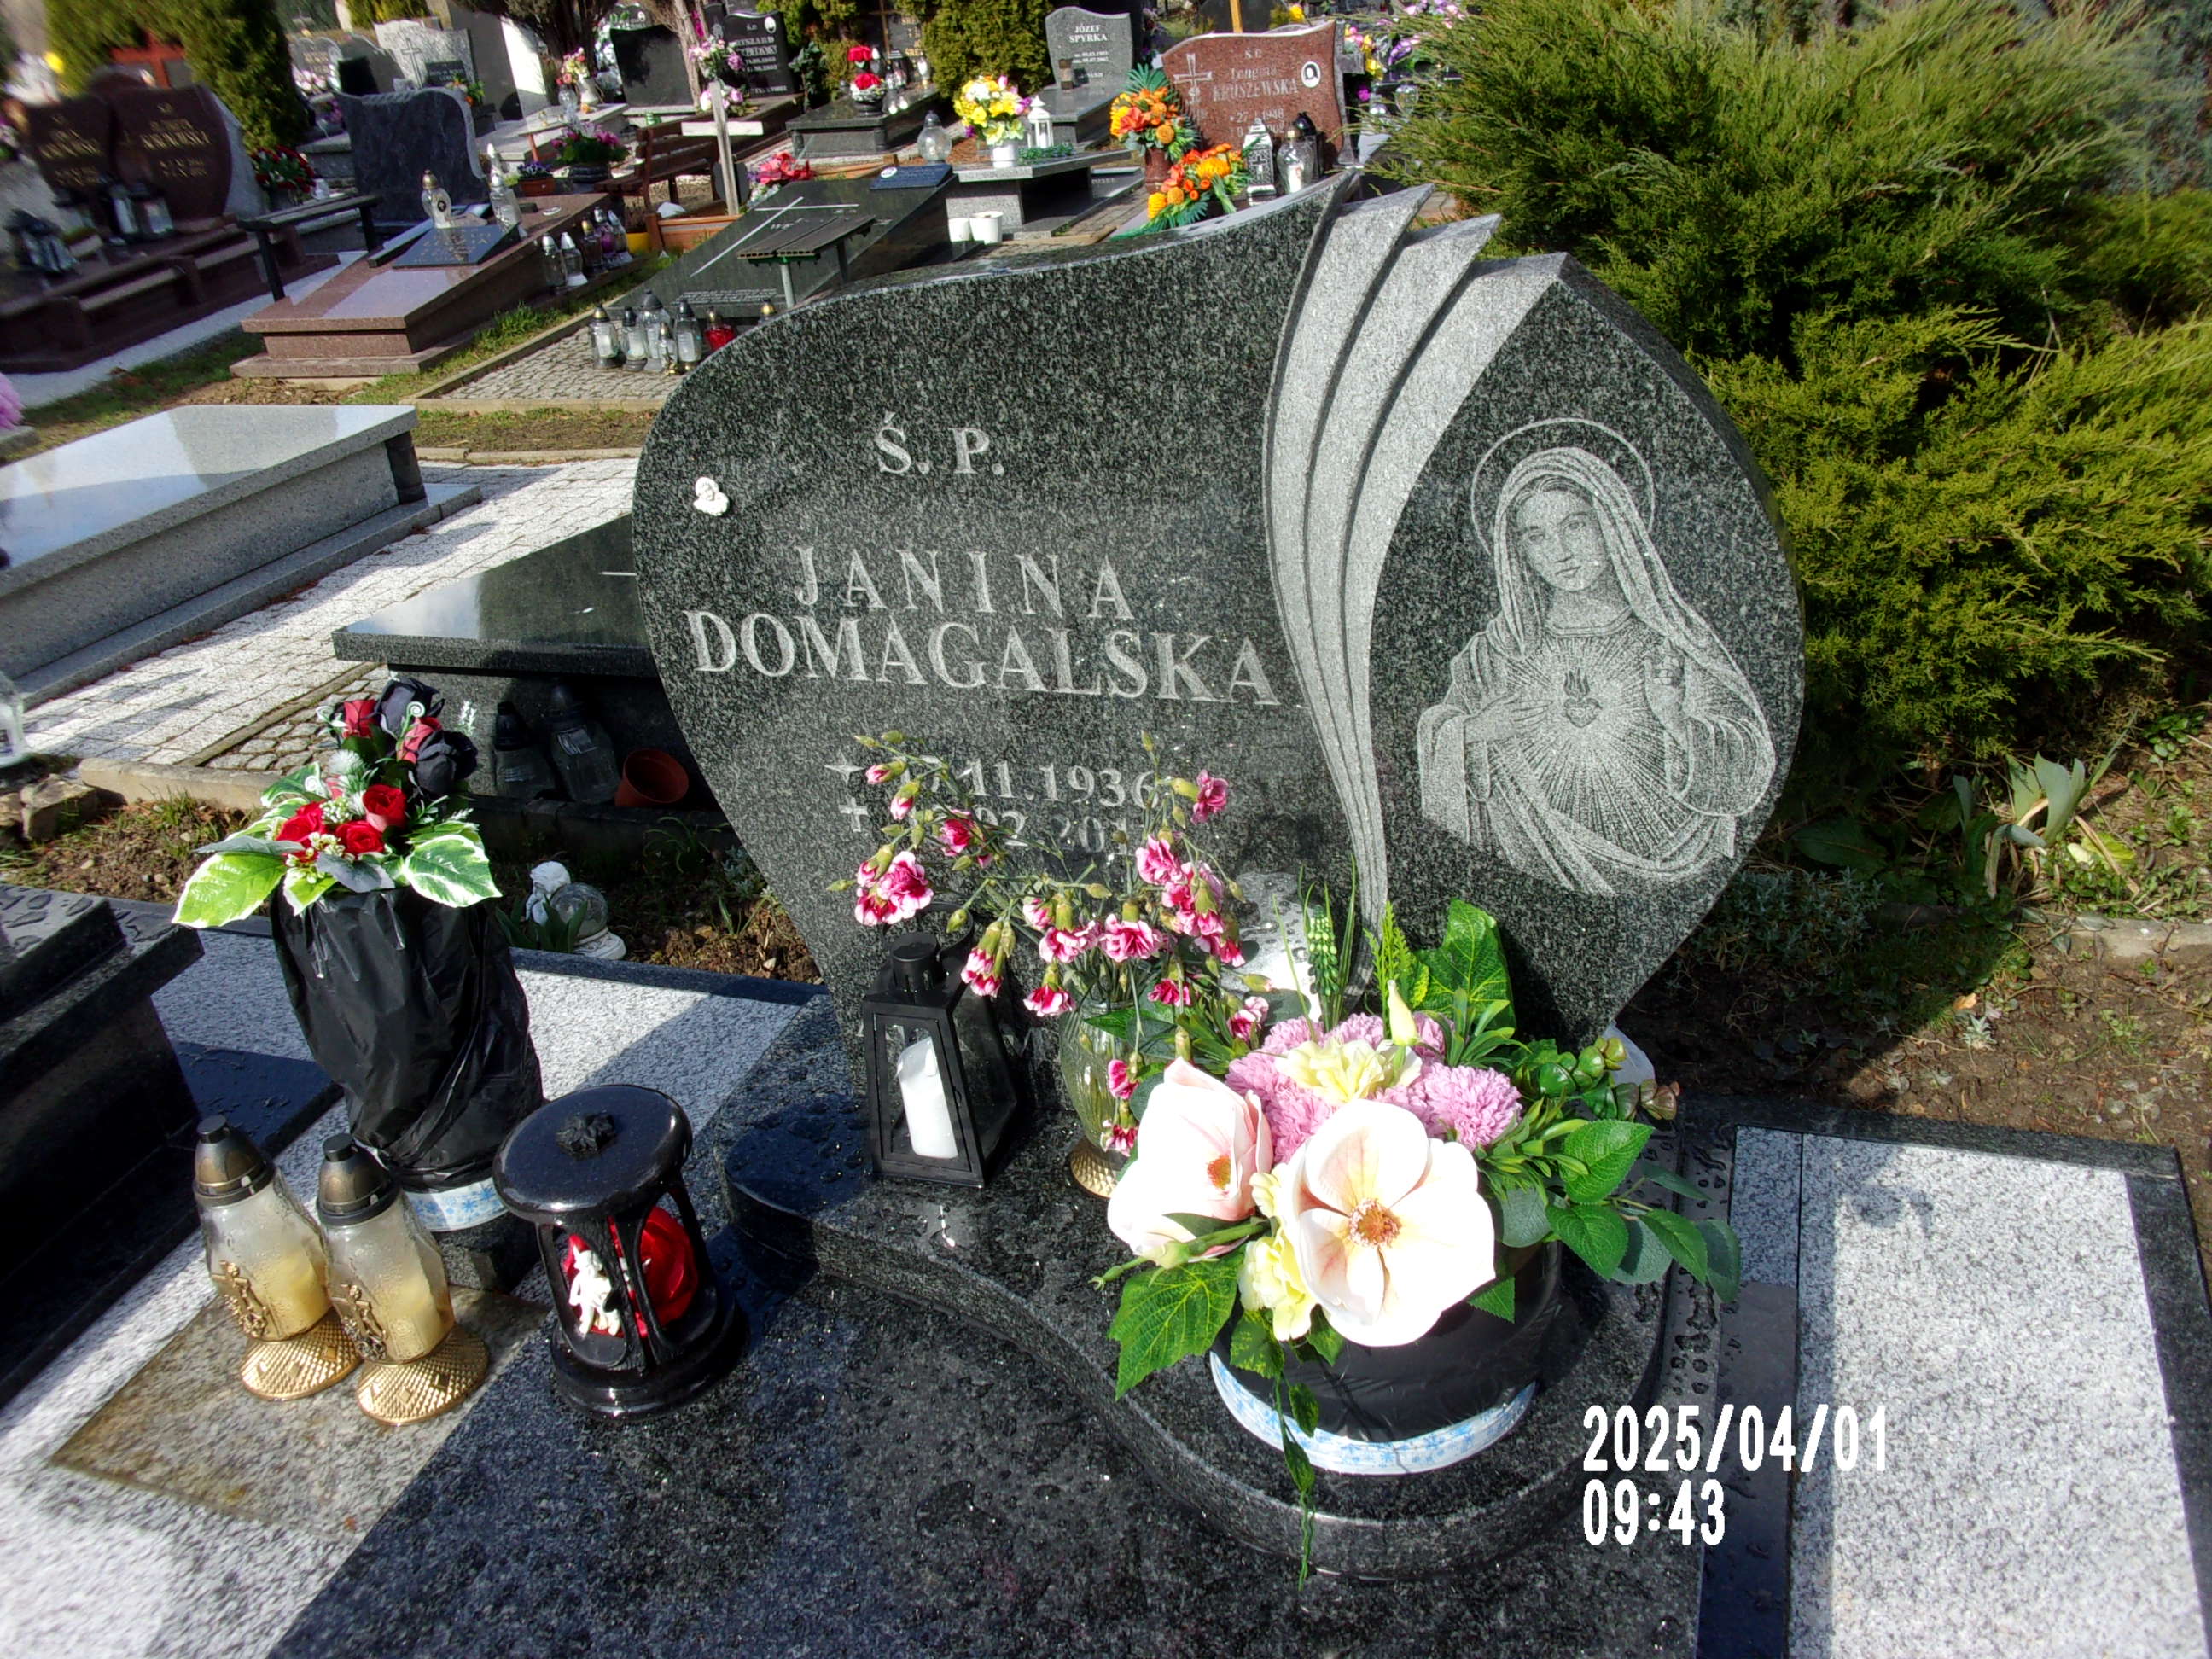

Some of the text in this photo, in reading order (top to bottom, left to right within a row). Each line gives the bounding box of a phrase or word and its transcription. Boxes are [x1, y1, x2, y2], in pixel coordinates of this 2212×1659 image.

[1068, 33, 1108, 43] SPYRKA
[1074, 23, 1101, 33] JÓZEF
[794, 545, 1136, 620] JANINA
[682, 608, 1282, 707] DOMAGALSKA
